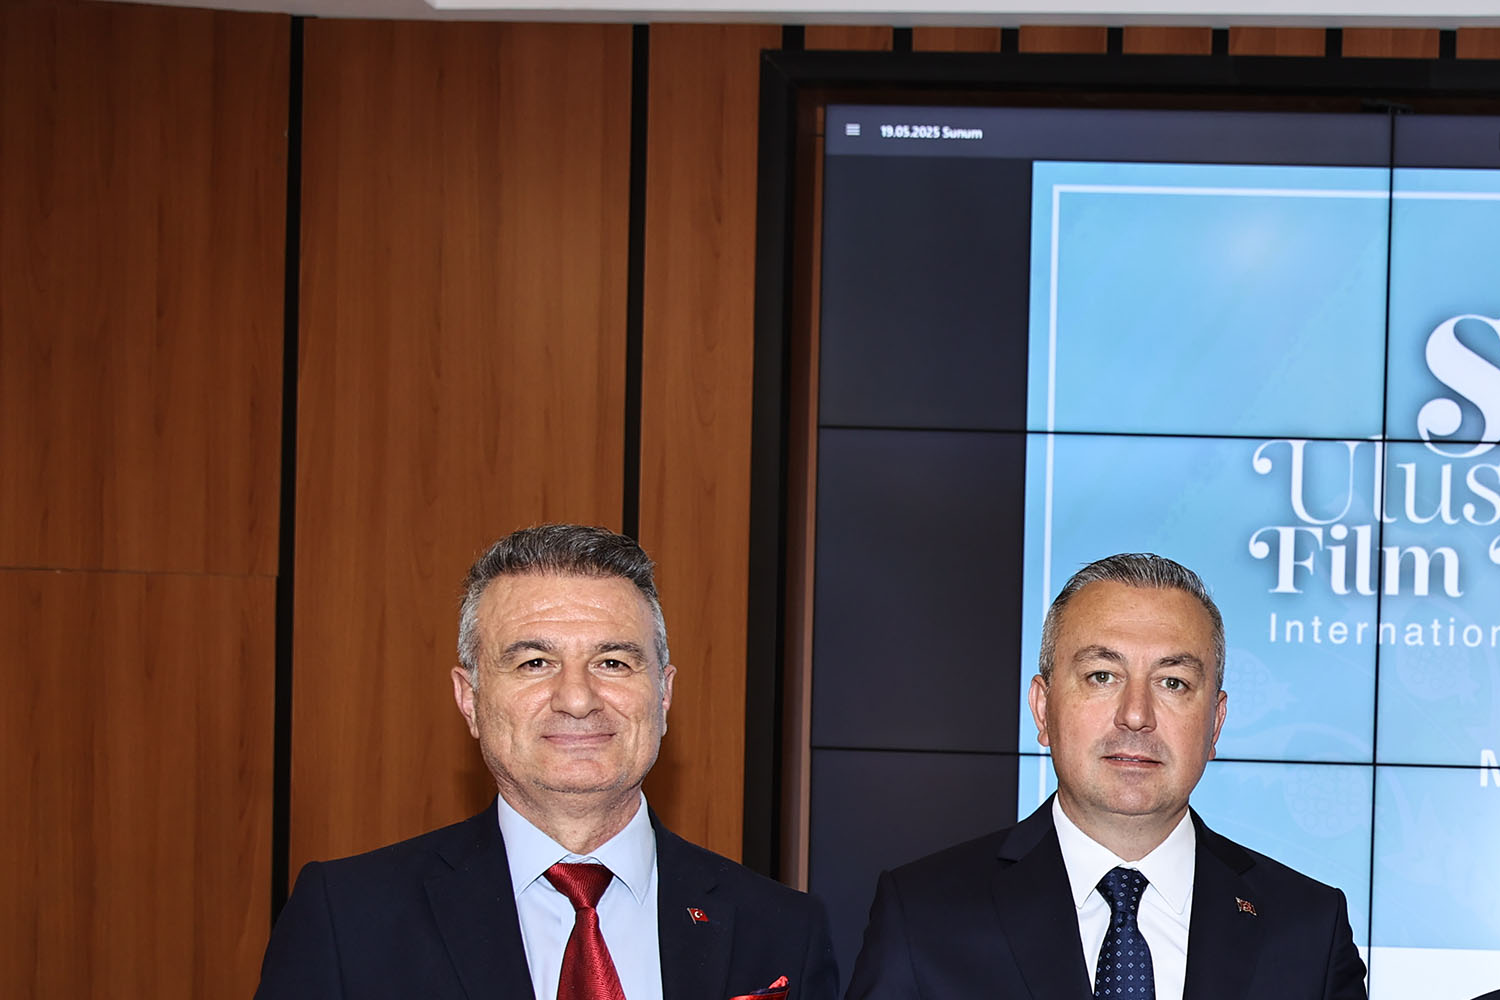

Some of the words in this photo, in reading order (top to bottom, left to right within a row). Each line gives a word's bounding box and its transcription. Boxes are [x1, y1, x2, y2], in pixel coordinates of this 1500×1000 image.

[880, 125, 940, 139] 19.05.2025
[942, 126, 983, 139] Sunum
[1249, 523, 1464, 598] Film
